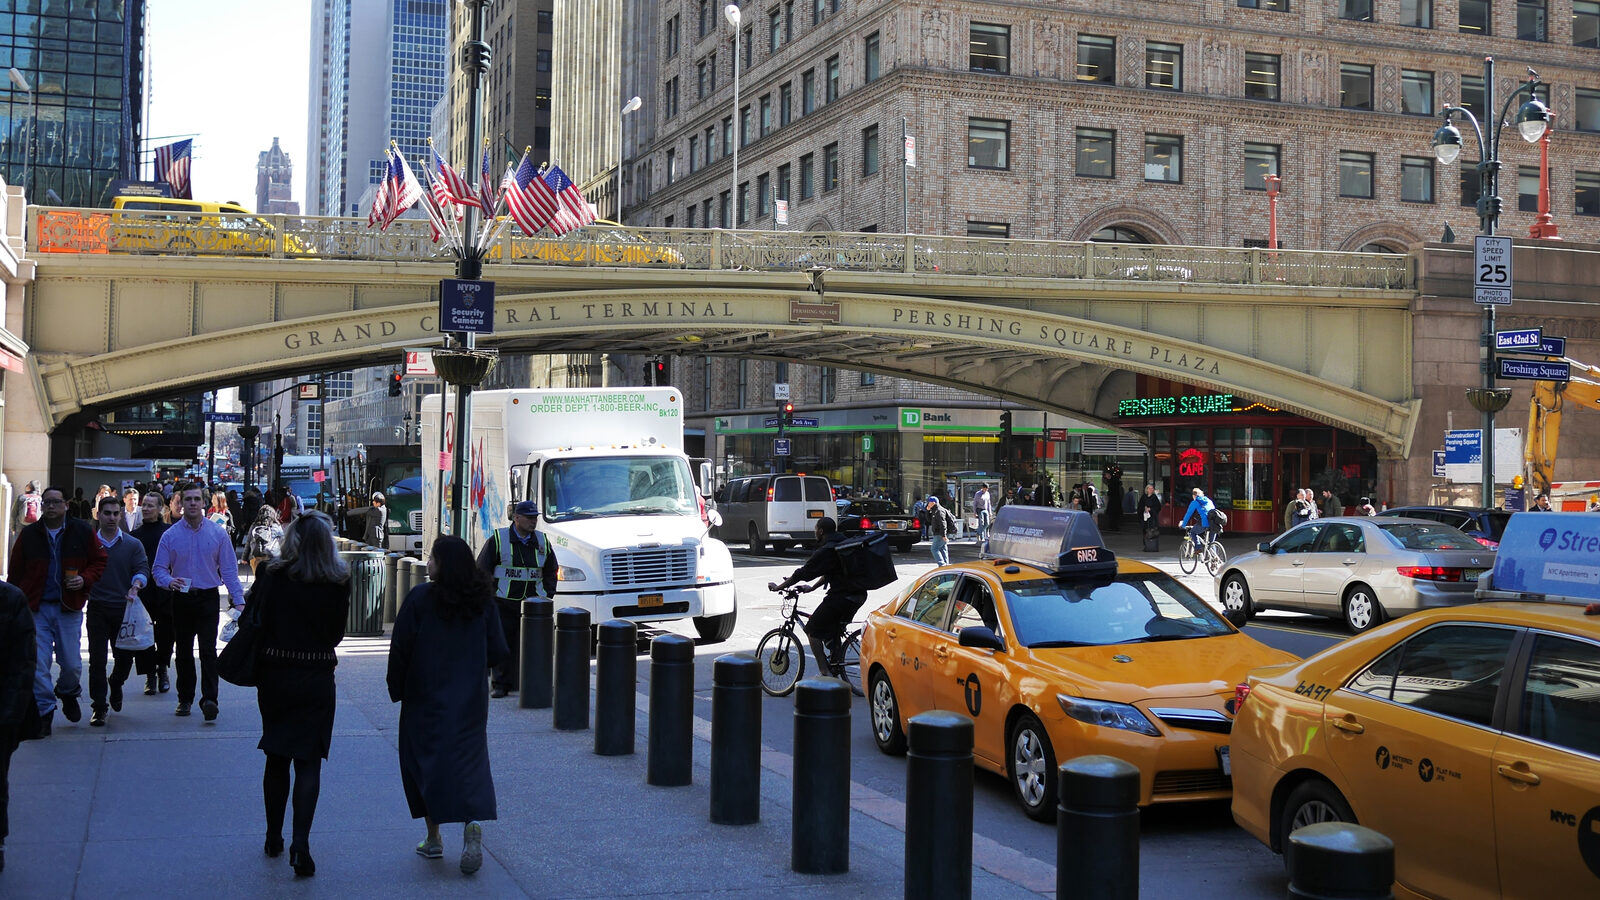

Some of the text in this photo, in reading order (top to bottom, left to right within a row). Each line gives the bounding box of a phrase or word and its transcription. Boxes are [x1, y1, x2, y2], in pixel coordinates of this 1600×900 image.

[1482, 247, 1504, 255] SPEED
[1484, 255, 1502, 263] LIMIT
[1480, 263, 1508, 284] 25
[457, 283, 481, 291] NYPD
[1477, 295, 1509, 303] ENFORCED
[451, 307, 485, 318] Security
[284, 302, 734, 350] GRAND CRAL TERMINAL
[452, 316, 484, 325] Camera
[893, 308, 1221, 376] PERSHING SQUARE PLAZA
[1498, 333, 1538, 346] East 42nd St
[1503, 363, 1567, 377] Pershing Square
[542, 394, 645, 404] WWW.MANHATTANBEER.COM
[530, 402, 659, 413] ORDER DEPT. 1-800-BEER-INC
[1119, 394, 1233, 416] PERSHING SQUARE
[659, 408, 679, 417] Bk120
[903, 412, 952, 424] TD Bank
[1558, 530, 1600, 552] Stre
[1077, 549, 1097, 562] 6N52
[505, 567, 522, 578] PUBLIC
[1559, 570, 1589, 578] Apartments
[1550, 809, 1576, 827] NYC
